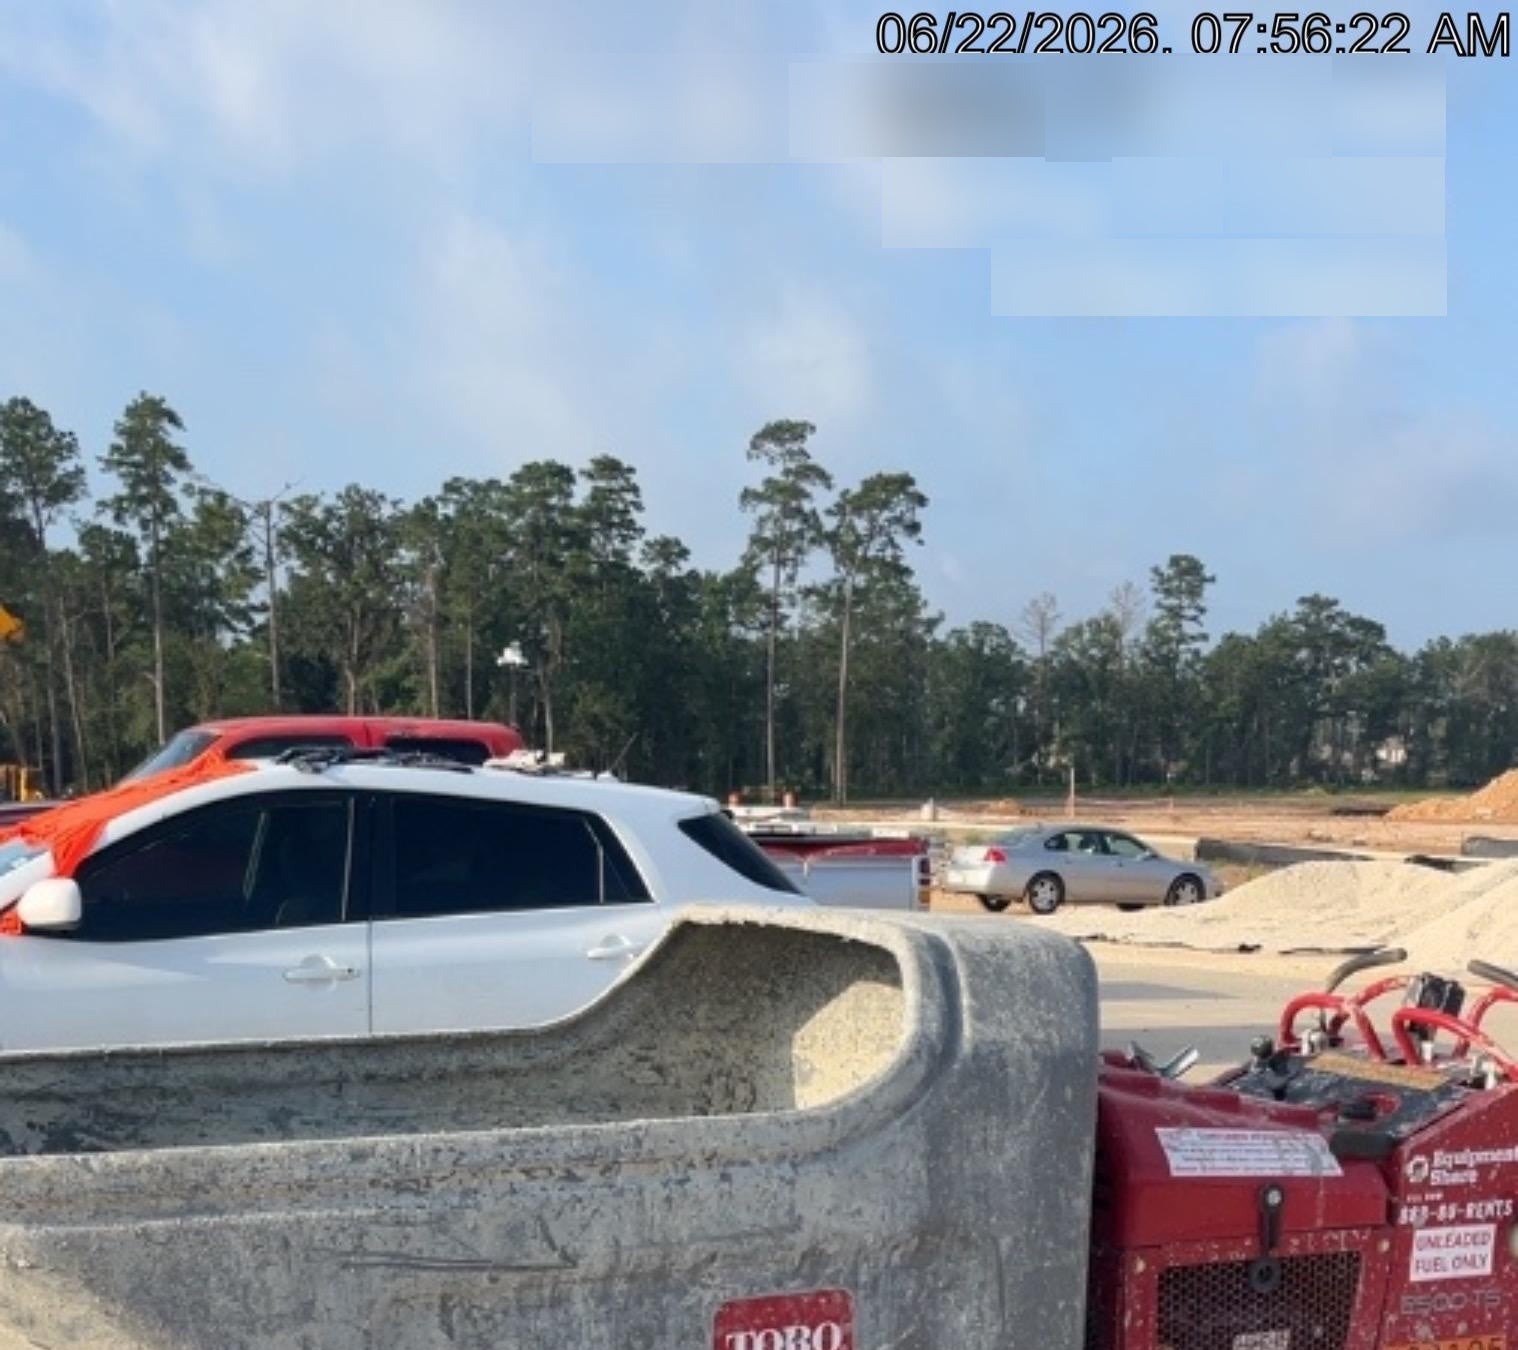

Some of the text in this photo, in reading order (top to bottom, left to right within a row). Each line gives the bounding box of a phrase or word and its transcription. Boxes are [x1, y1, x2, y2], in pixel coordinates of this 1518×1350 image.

[1416, 1231, 1492, 1251] UNLEADED
[1415, 1253, 1489, 1274] FUEL ONLY
